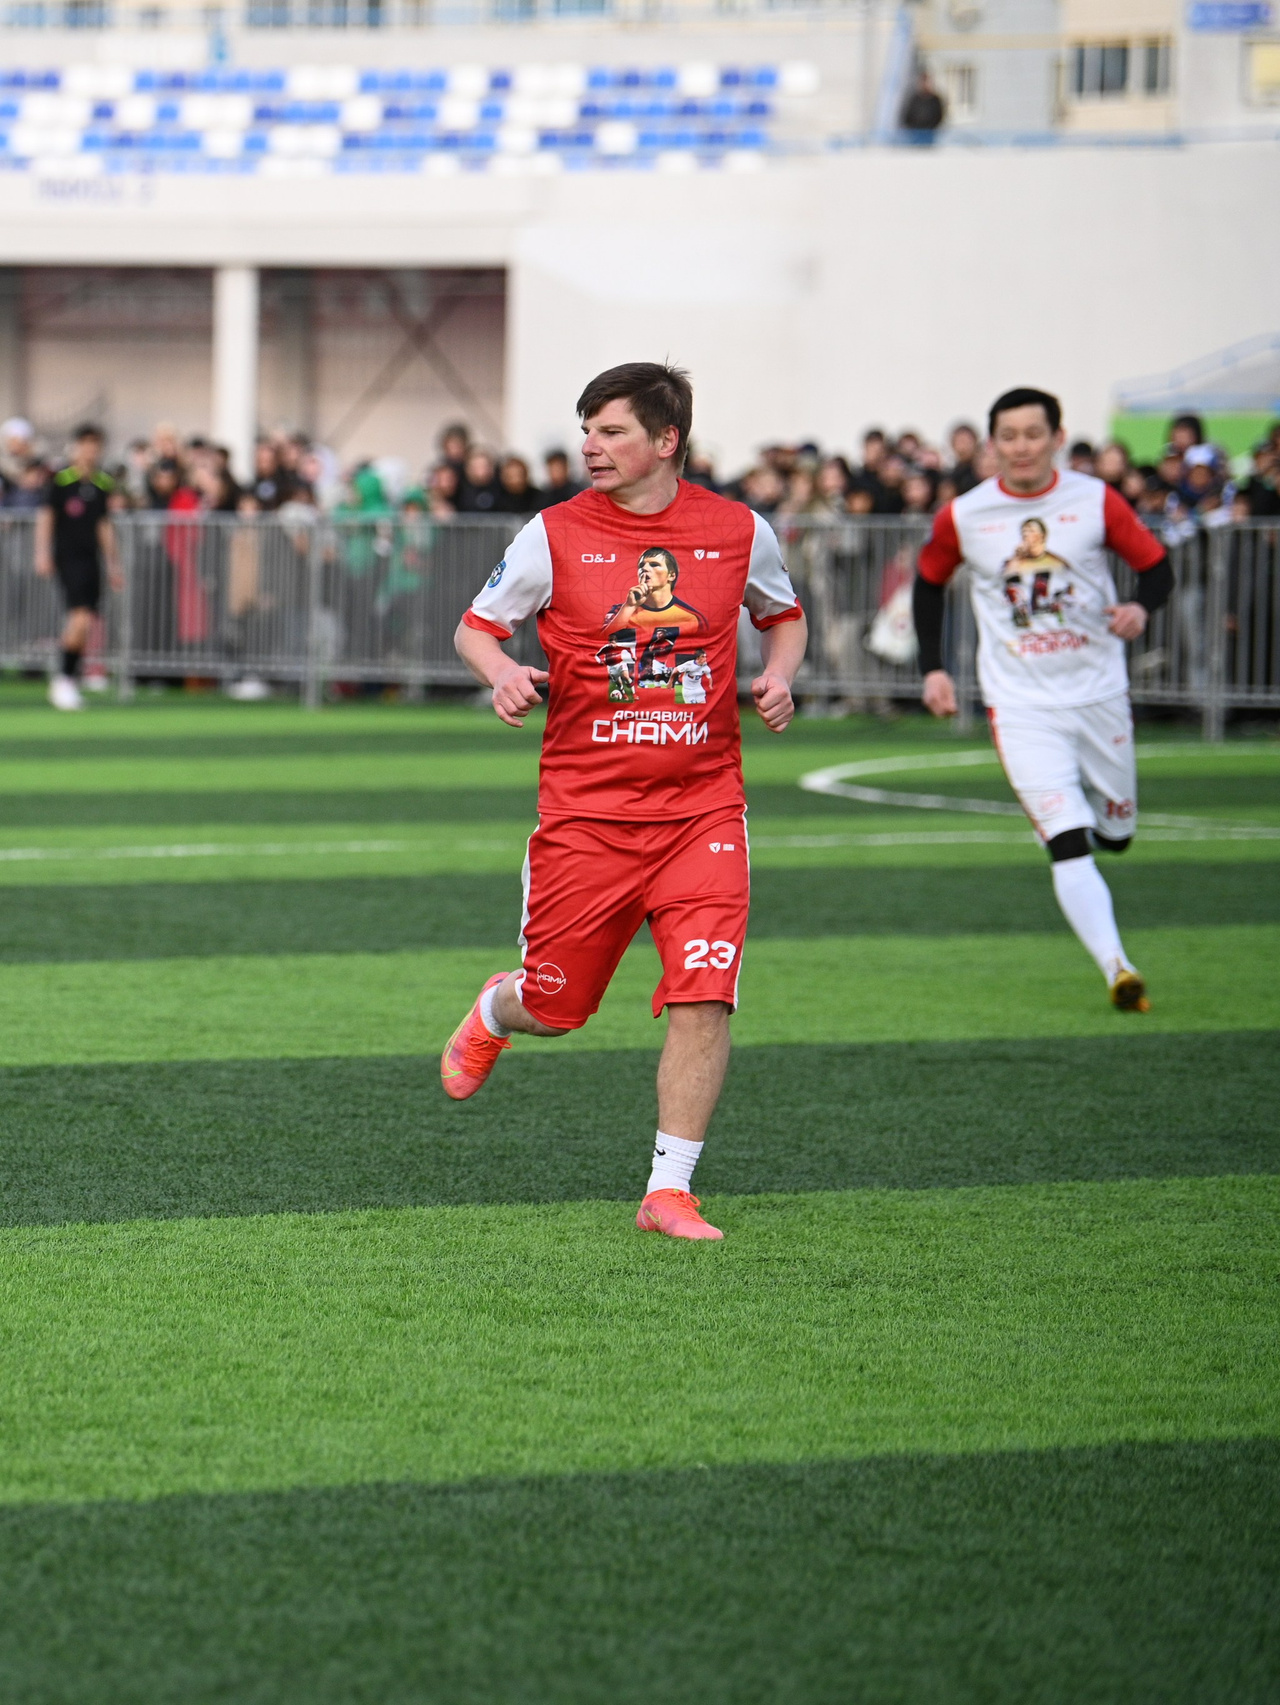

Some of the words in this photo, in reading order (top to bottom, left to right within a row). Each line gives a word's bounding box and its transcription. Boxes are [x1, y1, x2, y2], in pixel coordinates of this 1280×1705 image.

[581, 553, 616, 563] O&J
[612, 710, 694, 722] АРШАВИН
[592, 719, 708, 745] СНАМИ
[683, 939, 737, 970] 23
